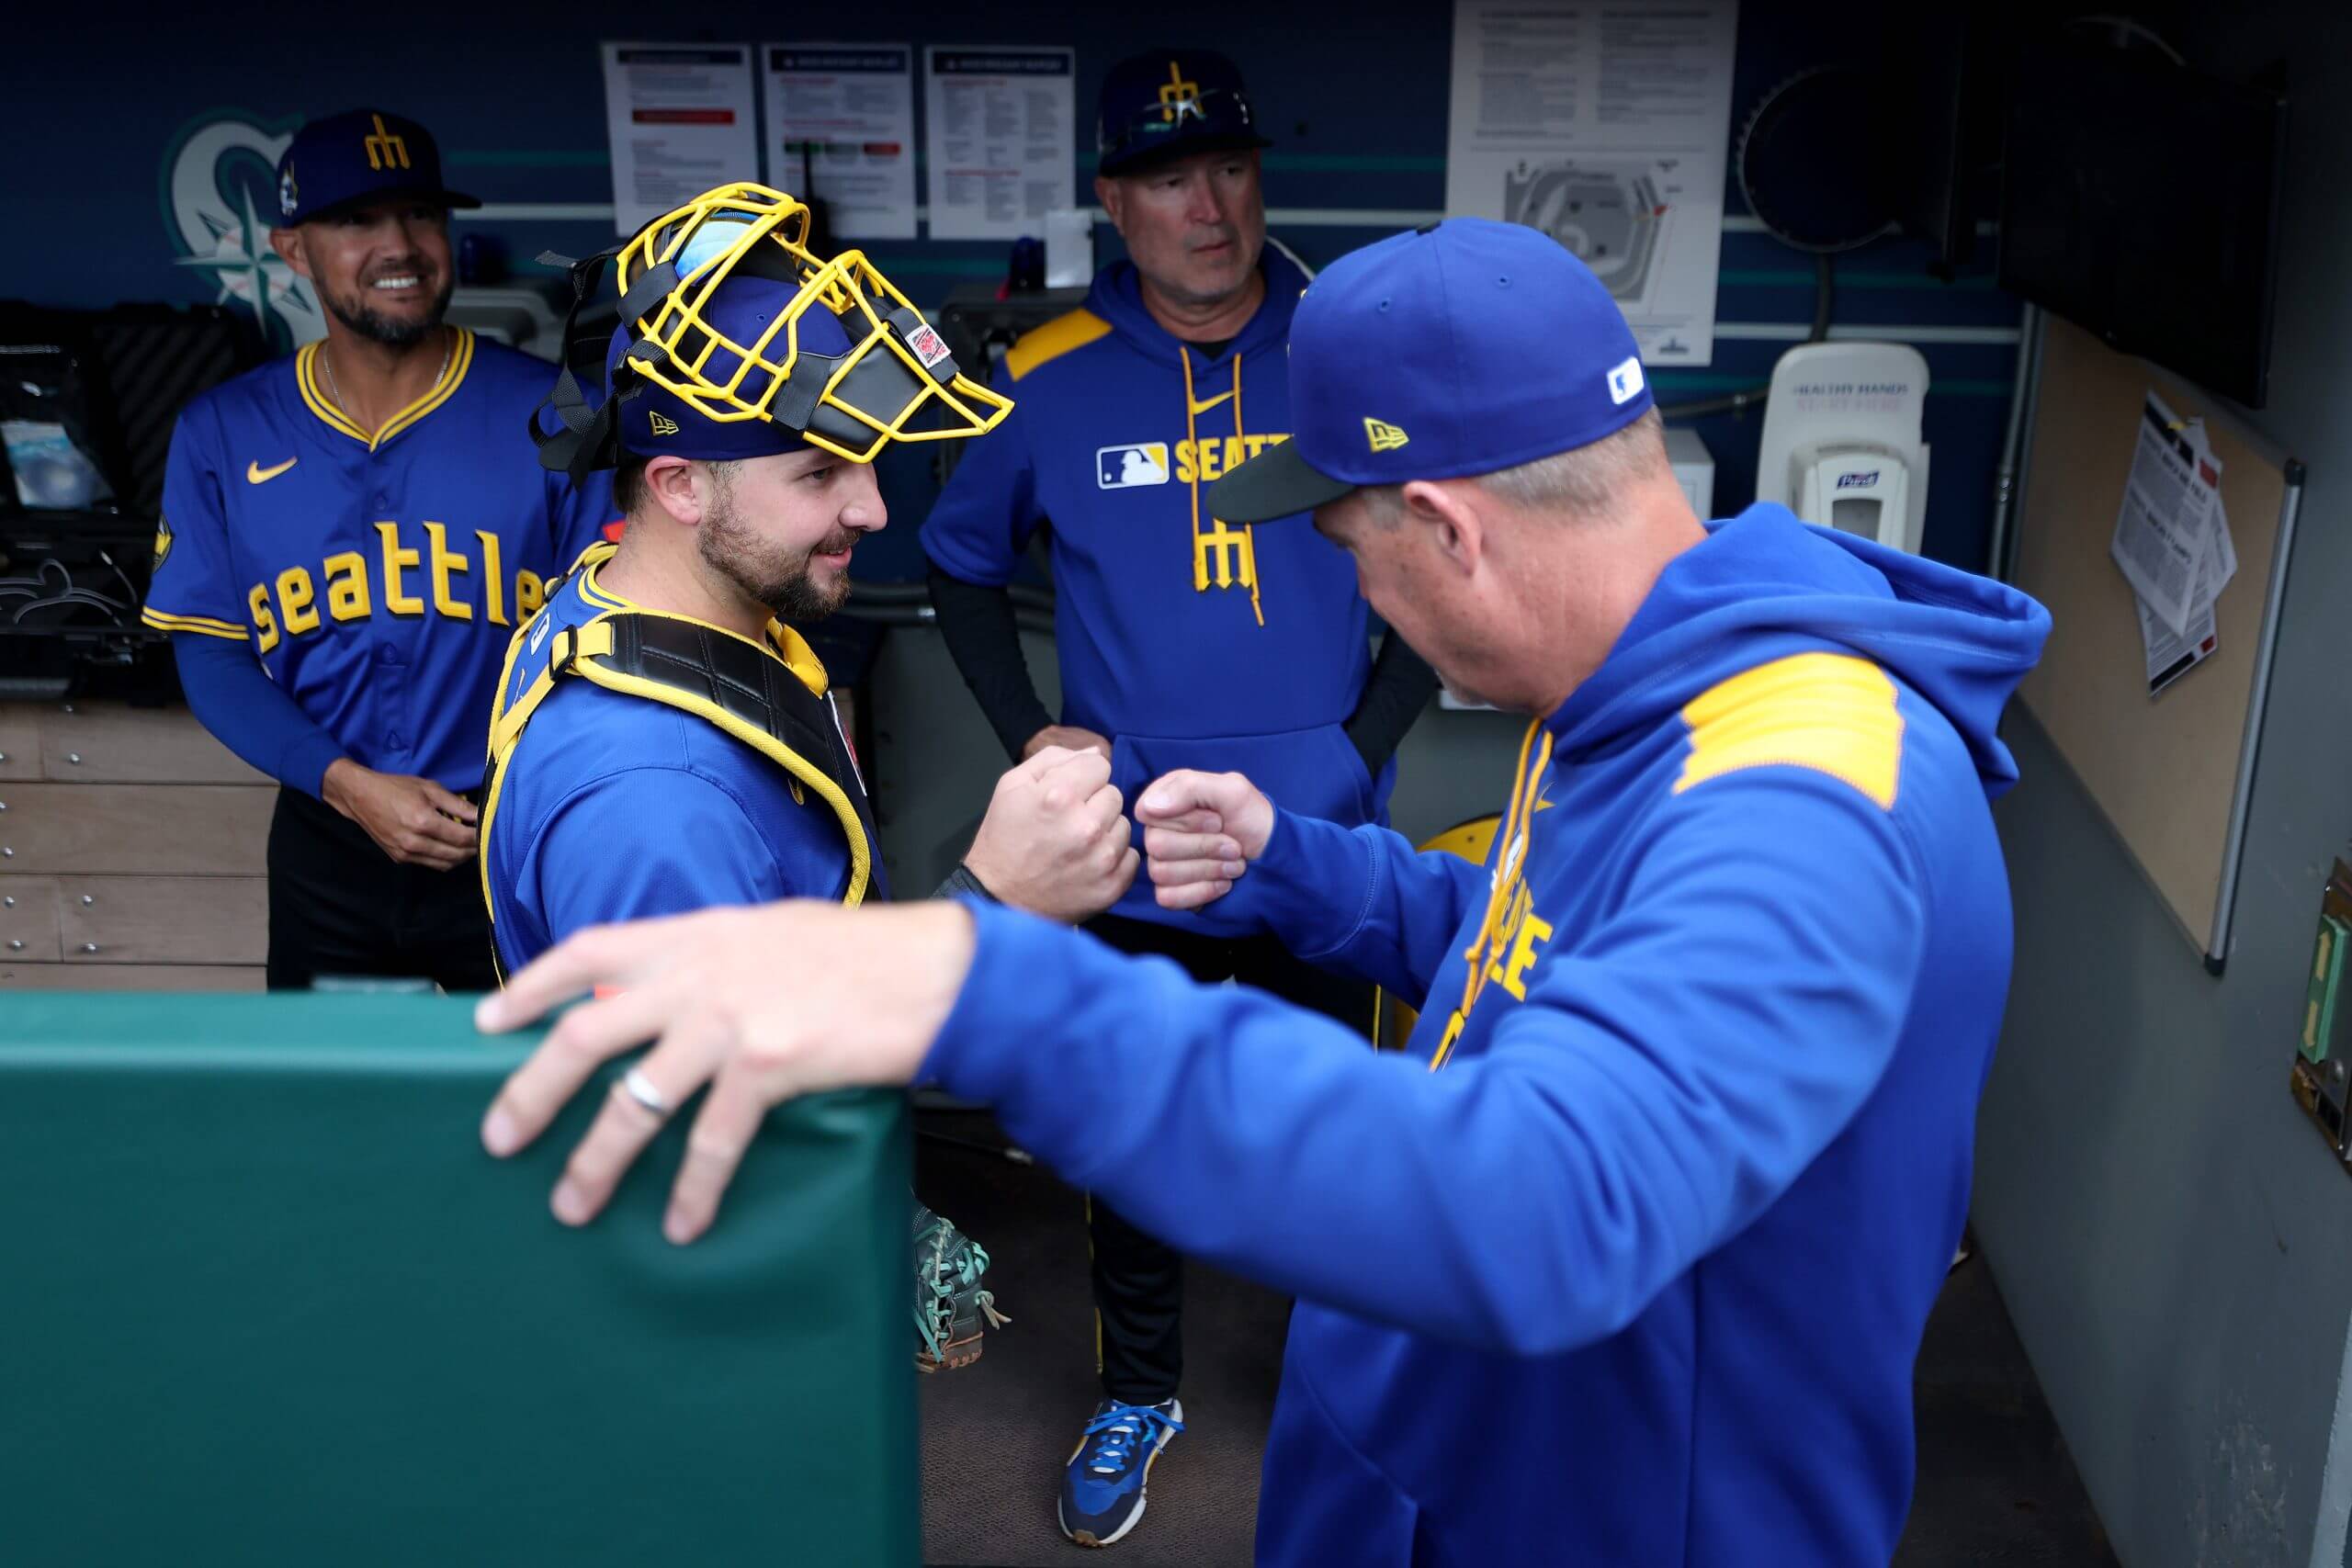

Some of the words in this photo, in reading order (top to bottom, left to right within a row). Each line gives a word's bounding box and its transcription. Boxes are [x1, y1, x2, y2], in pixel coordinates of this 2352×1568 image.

[1859, 382, 1909, 395] HANDS
[1174, 434, 1292, 483] SEAT
[247, 520, 544, 654] seattle
